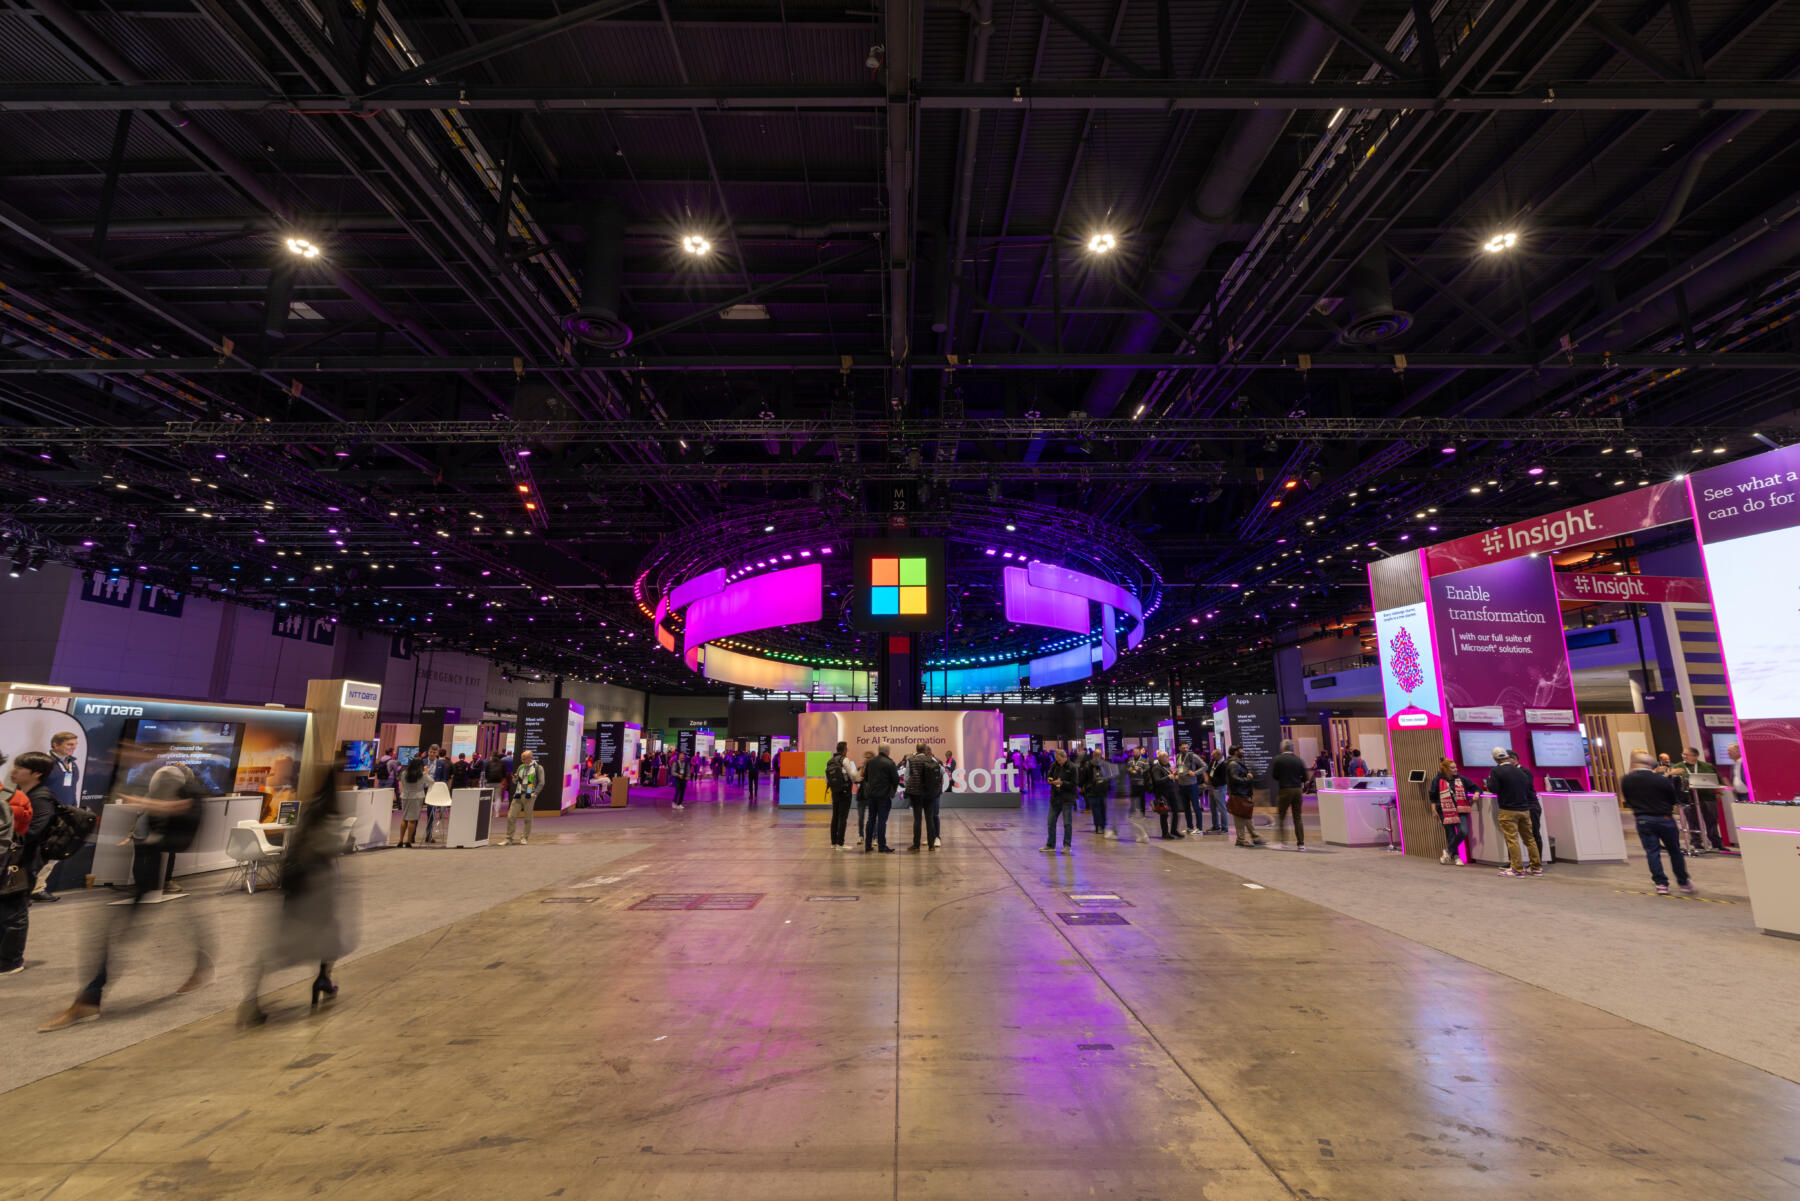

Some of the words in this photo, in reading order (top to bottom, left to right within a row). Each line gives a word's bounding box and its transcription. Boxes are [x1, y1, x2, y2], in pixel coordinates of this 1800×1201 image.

[1703, 487, 1734, 502] See
[1736, 474, 1783, 493] what
[1786, 471, 1799, 481] a
[894, 489, 904, 498] M
[893, 501, 905, 511] 32
[1708, 506, 1740, 520] can
[1743, 498, 1766, 513] do
[1769, 492, 1796, 507] for
[1445, 585, 1491, 602] Enable
[1448, 606, 1546, 624] transformation
[1459, 632, 1476, 642] with
[1491, 633, 1504, 642] full
[1505, 634, 1523, 643] suite
[1523, 635, 1532, 643] of
[1498, 645, 1534, 654] solutions.
[465, 676, 480, 687] EXIT
[348, 690, 362, 699] NTT
[84, 703, 111, 715] NTT
[527, 701, 550, 709] Industry
[363, 711, 375, 720] 209
[863, 724, 888, 734] Latest
[890, 724, 940, 734] Innovations
[856, 736, 870, 745] For
[871, 736, 880, 745] AI
[882, 736, 946, 745] Transformation
